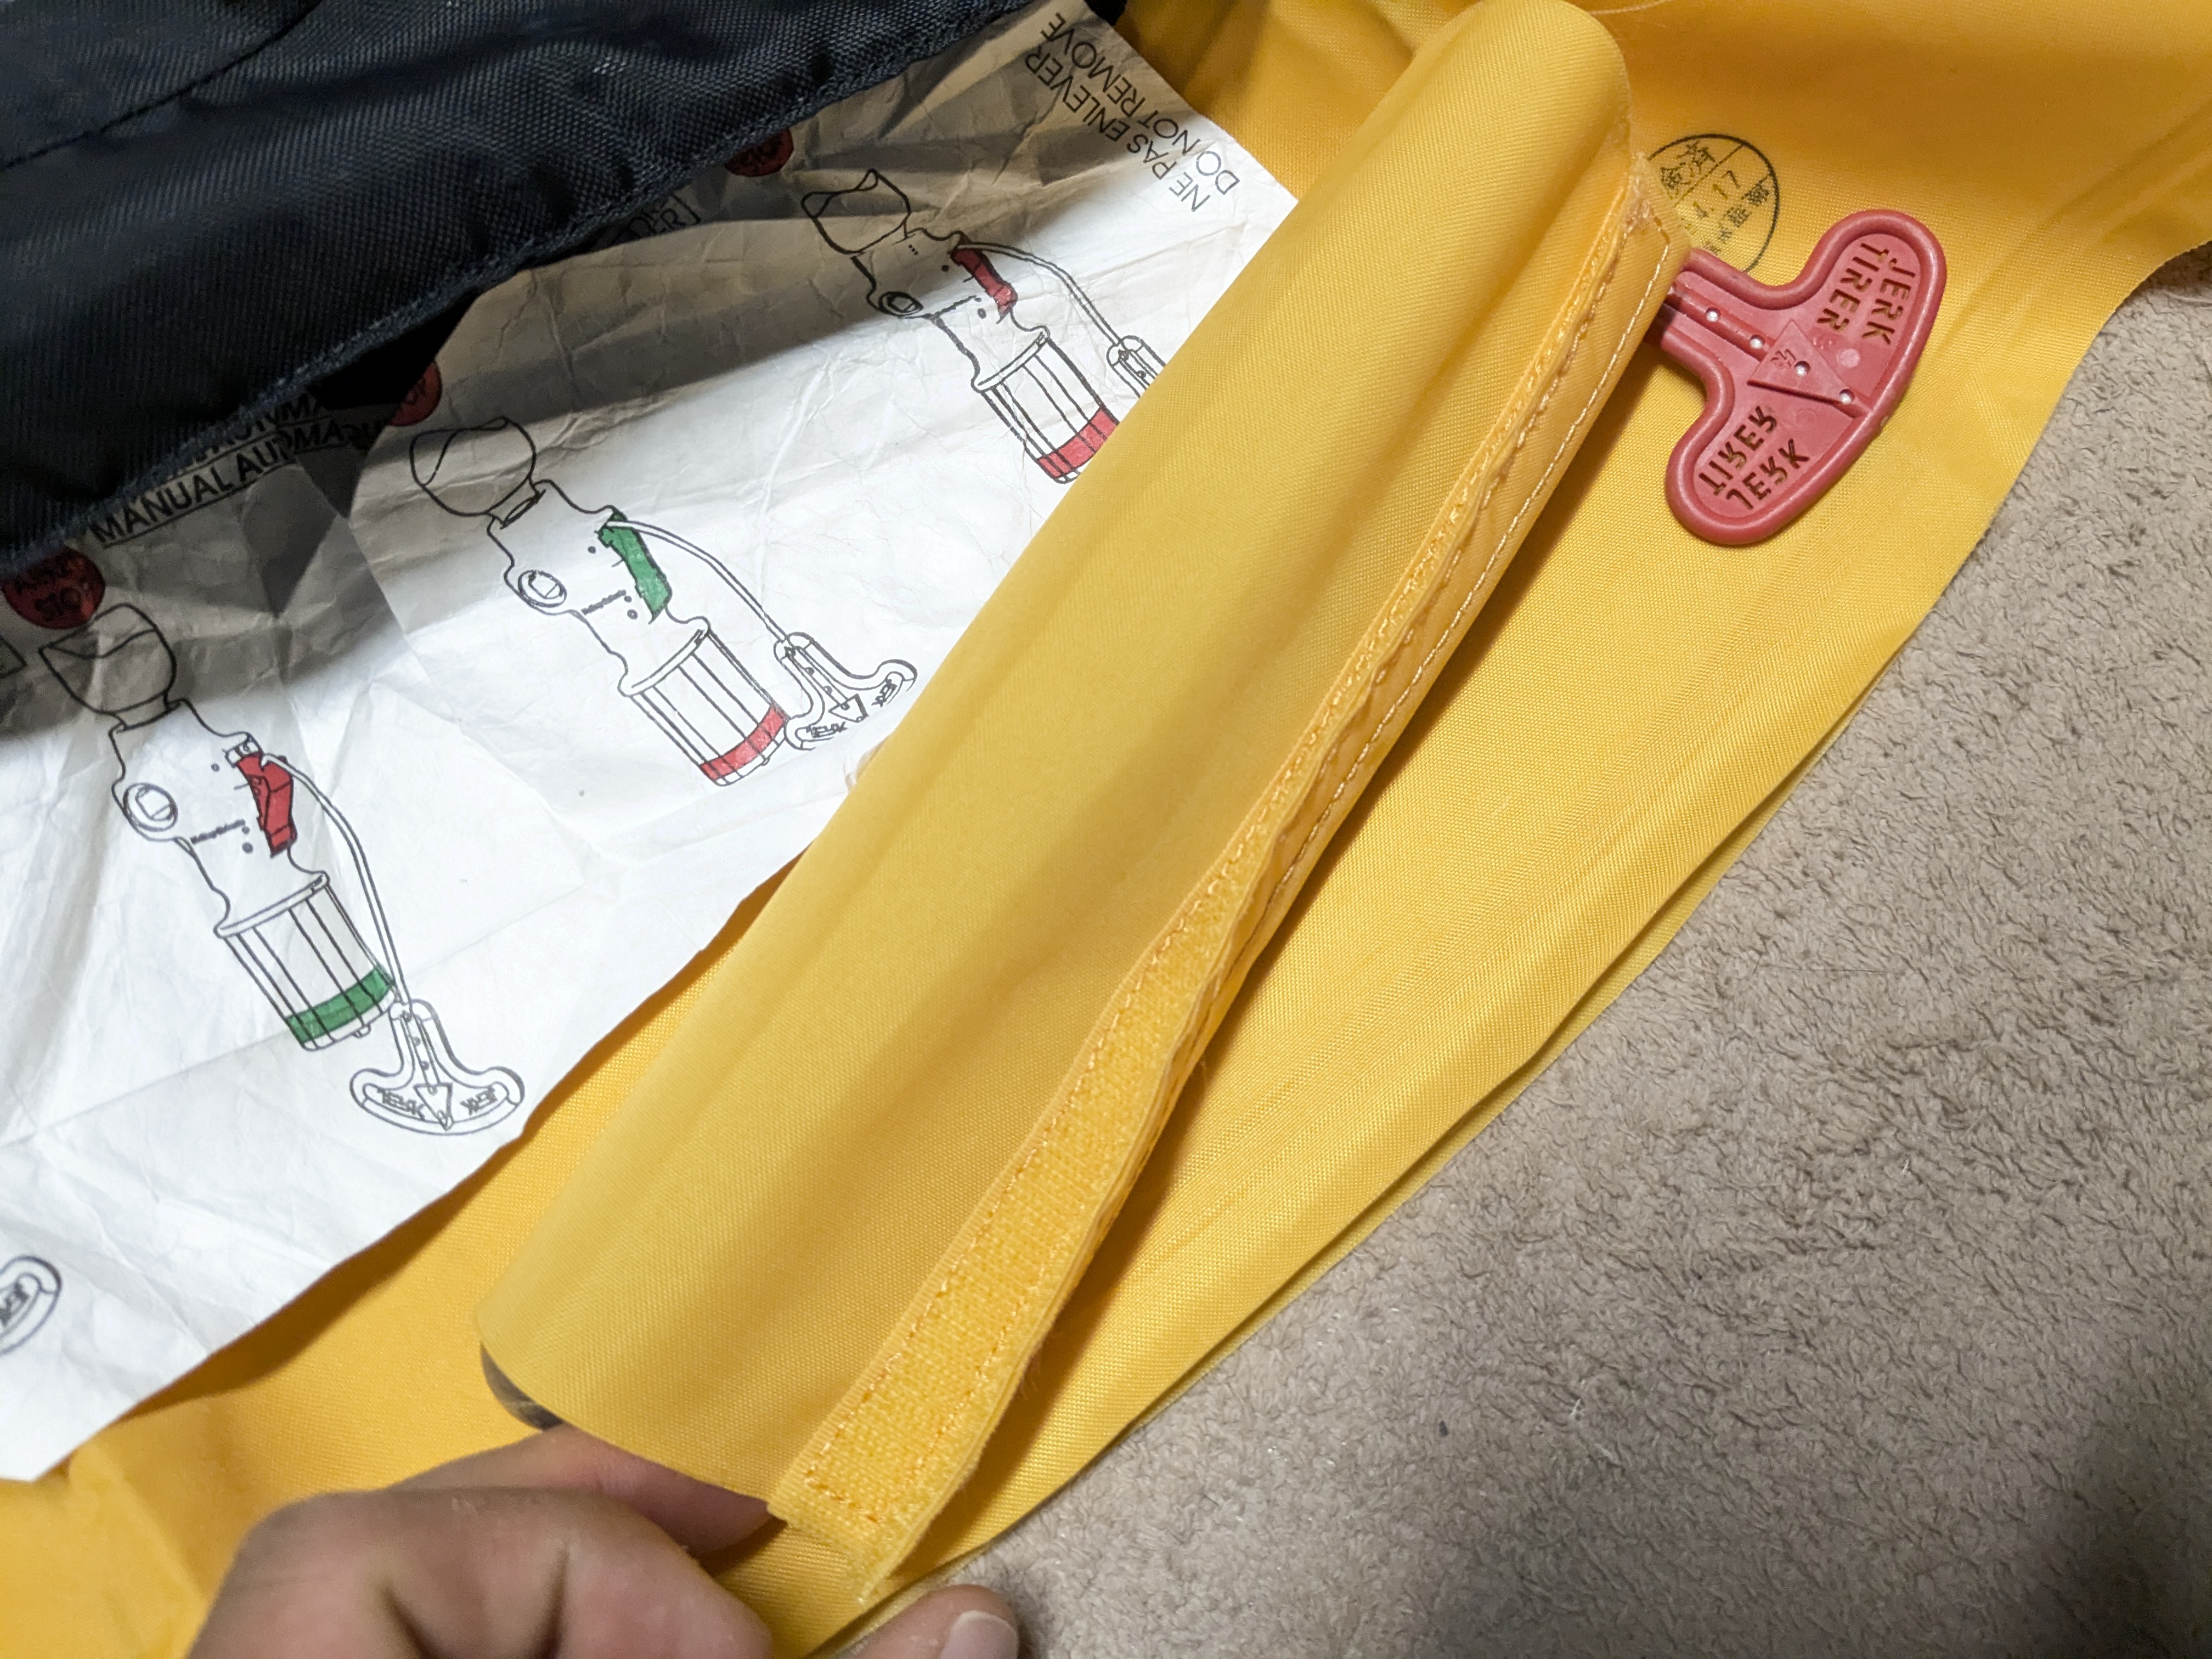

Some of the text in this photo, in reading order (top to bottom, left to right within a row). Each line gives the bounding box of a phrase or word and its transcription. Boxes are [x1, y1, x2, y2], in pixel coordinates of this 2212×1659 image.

[1024, 46, 1211, 212] NE PAS ENLEVER
[1040, 12, 1240, 195] DO NOT REMOVE
[1816, 242, 1888, 334] TIRER
[1861, 256, 1916, 347] JERK
[89, 462, 234, 545] MANUAL
